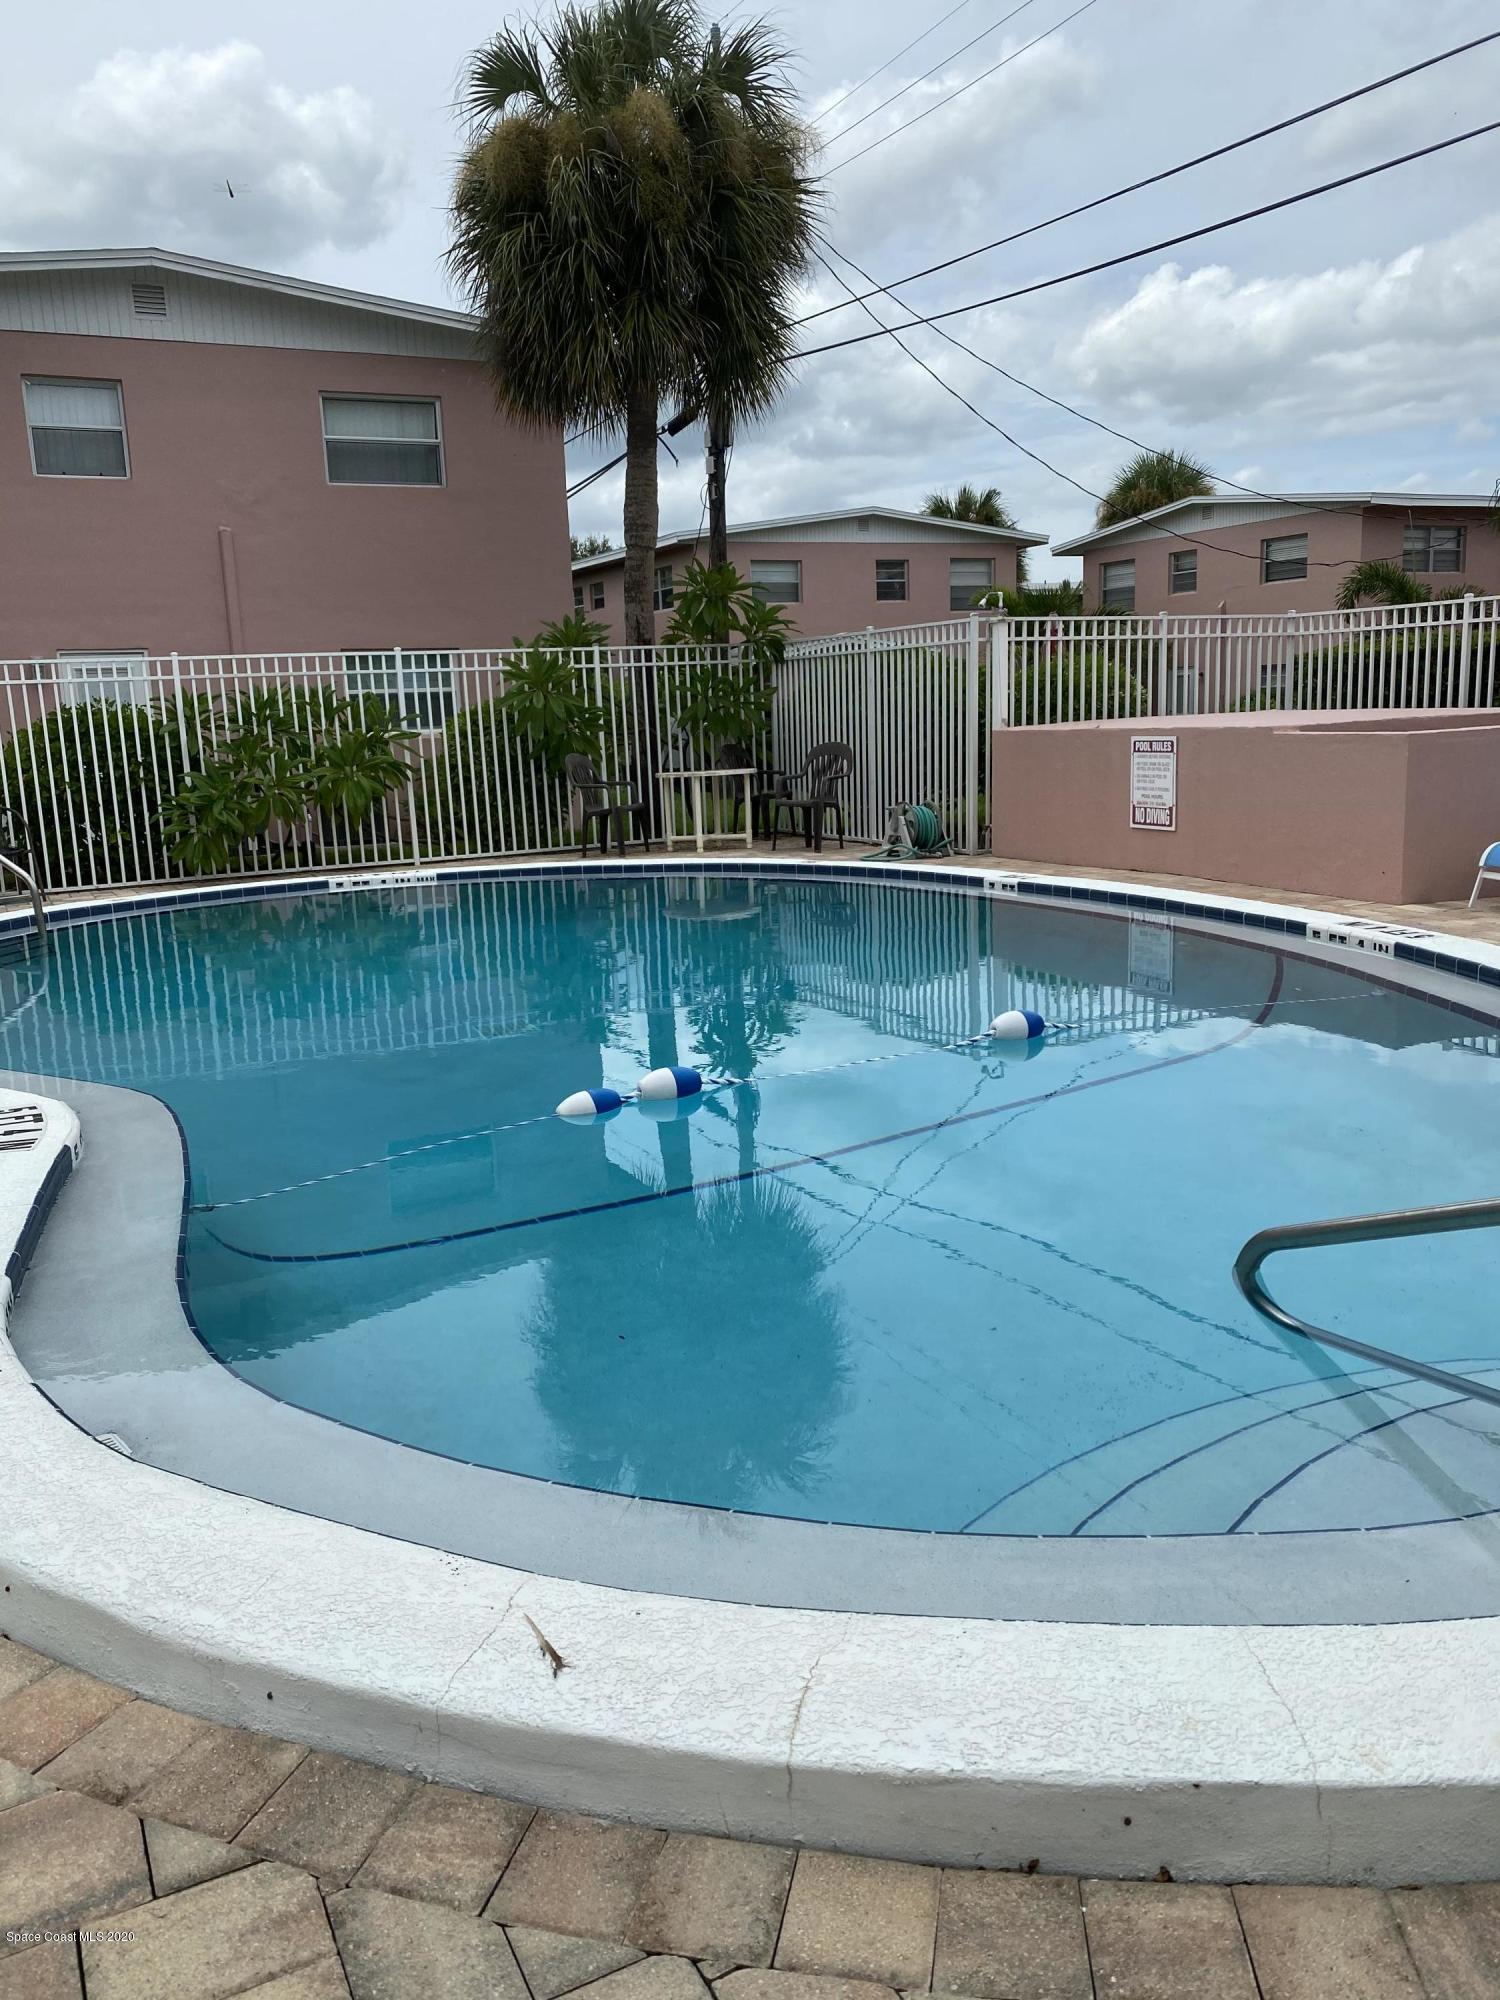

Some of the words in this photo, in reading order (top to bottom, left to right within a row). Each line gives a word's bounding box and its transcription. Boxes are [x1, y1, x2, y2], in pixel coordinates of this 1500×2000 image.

[1135, 741, 1152, 751] POOL
[1152, 742, 1172, 752] RULES
[1135, 807, 1144, 823] NO
[1145, 808, 1170, 825] DIVING
[1357, 939, 1365, 948] 4
[1373, 942, 1389, 954] IN
